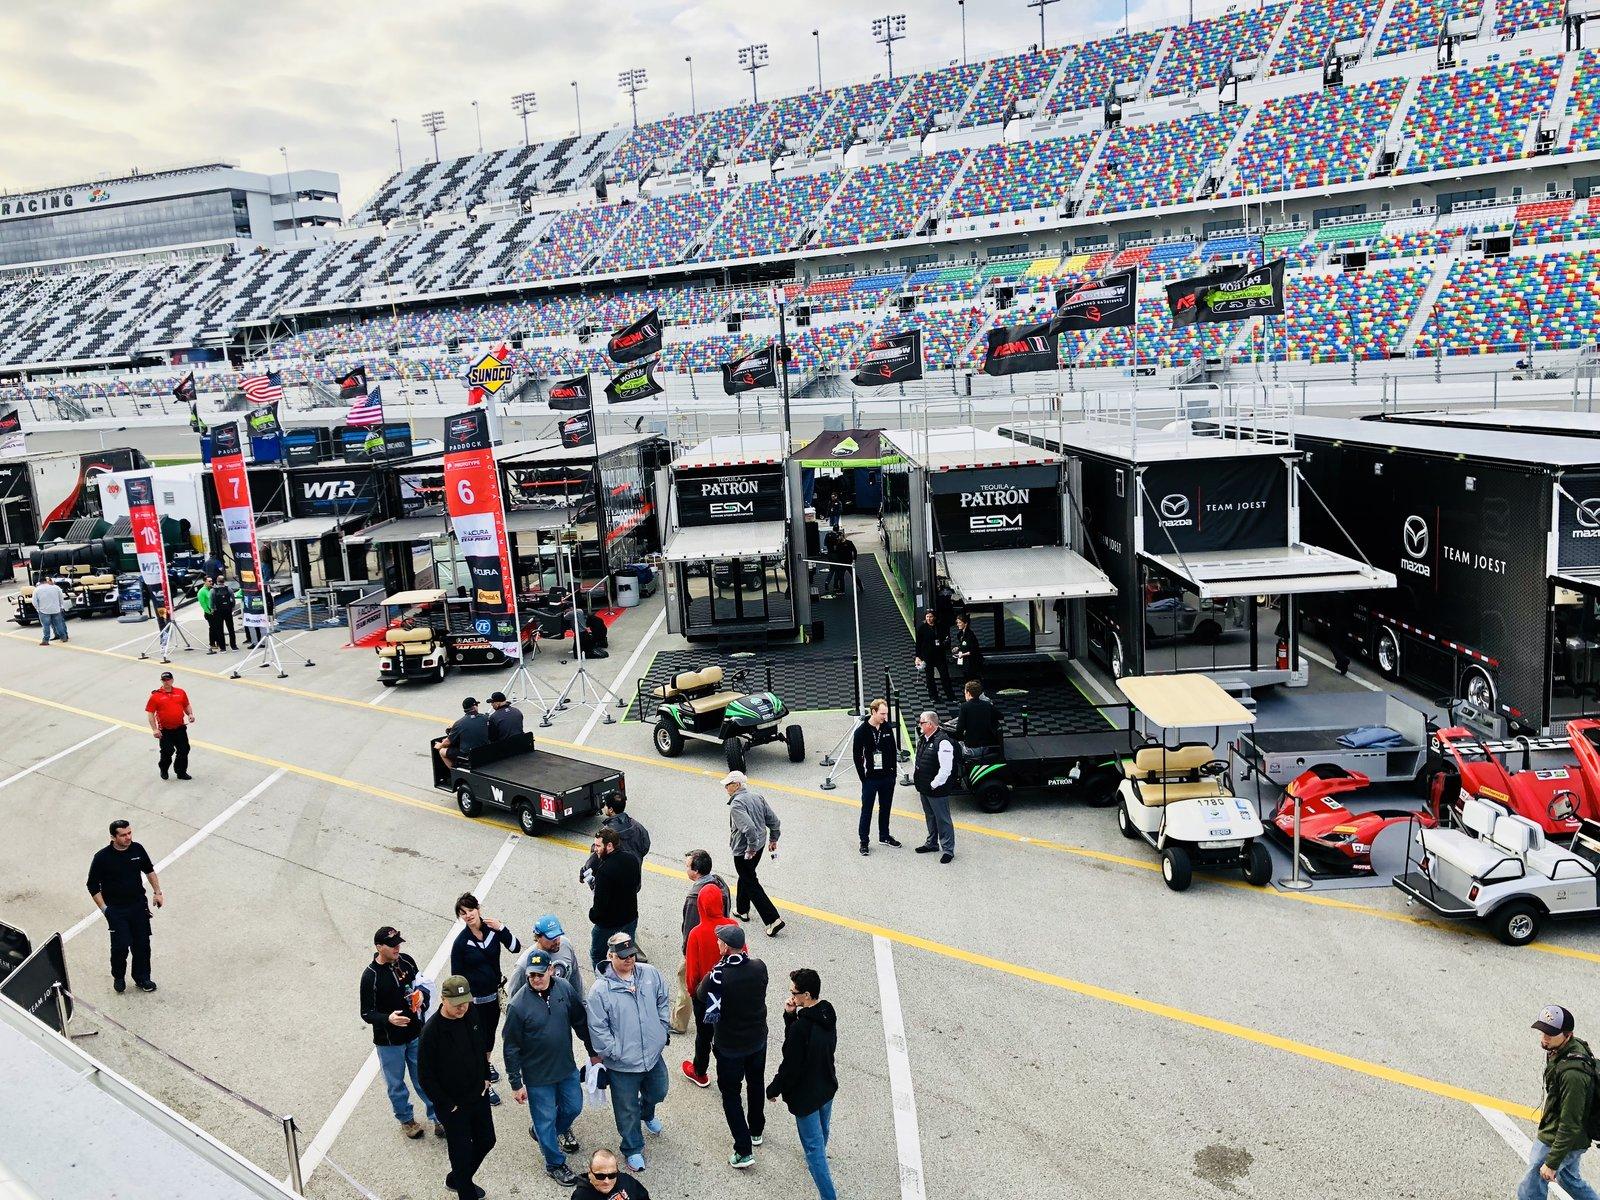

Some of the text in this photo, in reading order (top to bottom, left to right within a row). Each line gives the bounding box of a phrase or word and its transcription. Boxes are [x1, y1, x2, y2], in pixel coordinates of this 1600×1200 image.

[1, 193, 73, 215] RACING
[471, 366, 512, 382] SUNOCO
[449, 441, 482, 451] PADDOCK
[229, 477, 241, 499] 7
[303, 480, 356, 500] WTR
[457, 479, 476, 505] 6
[701, 478, 759, 497] PATRÓN
[960, 485, 1030, 507] PATRÓN
[710, 500, 753, 514] ESM
[1206, 501, 1267, 512] TEAM JOEST
[970, 513, 1022, 528] ESM
[140, 526, 157, 546] 10
[1572, 530, 1600, 538] maz
[1401, 558, 1431, 577] mazda
[1443, 546, 1506, 575] TEAM JOEST
[478, 622, 488, 632] ZF
[543, 799, 554, 811] 31
[28, 997, 44, 1014] TEAM
